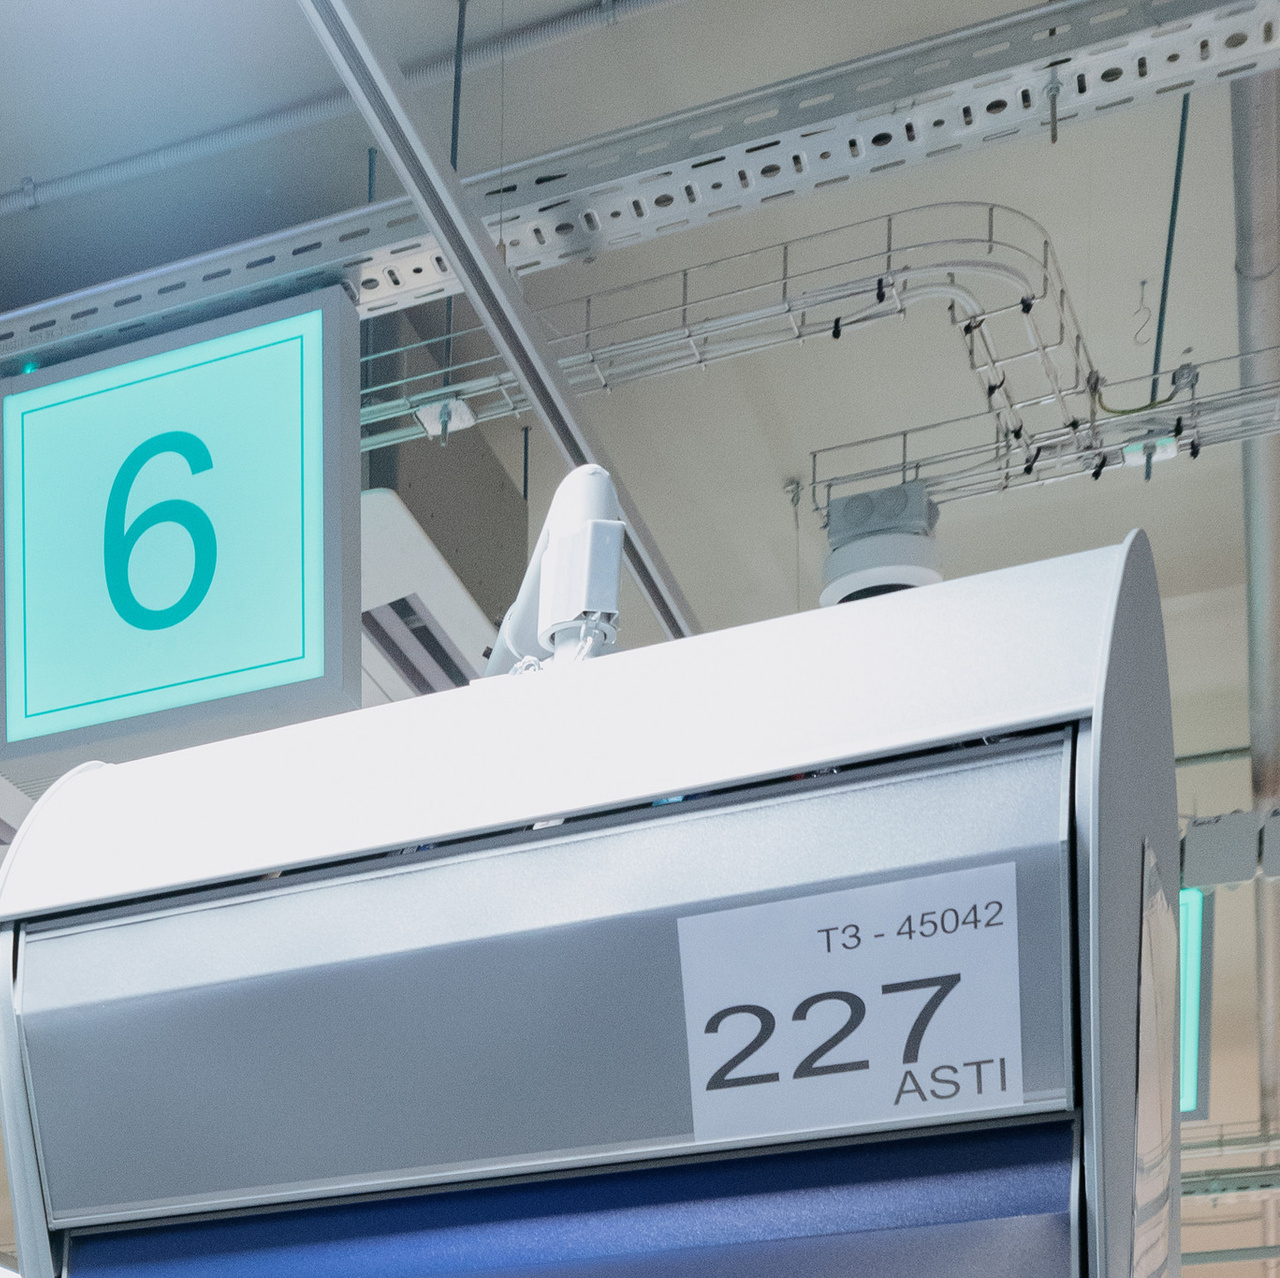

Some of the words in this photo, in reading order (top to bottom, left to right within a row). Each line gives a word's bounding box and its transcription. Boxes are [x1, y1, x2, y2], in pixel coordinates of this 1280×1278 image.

[104, 431, 217, 630] 6
[896, 901, 1004, 941] 45042
[704, 973, 961, 1091] 227
[894, 1057, 1007, 1106] ASTI
